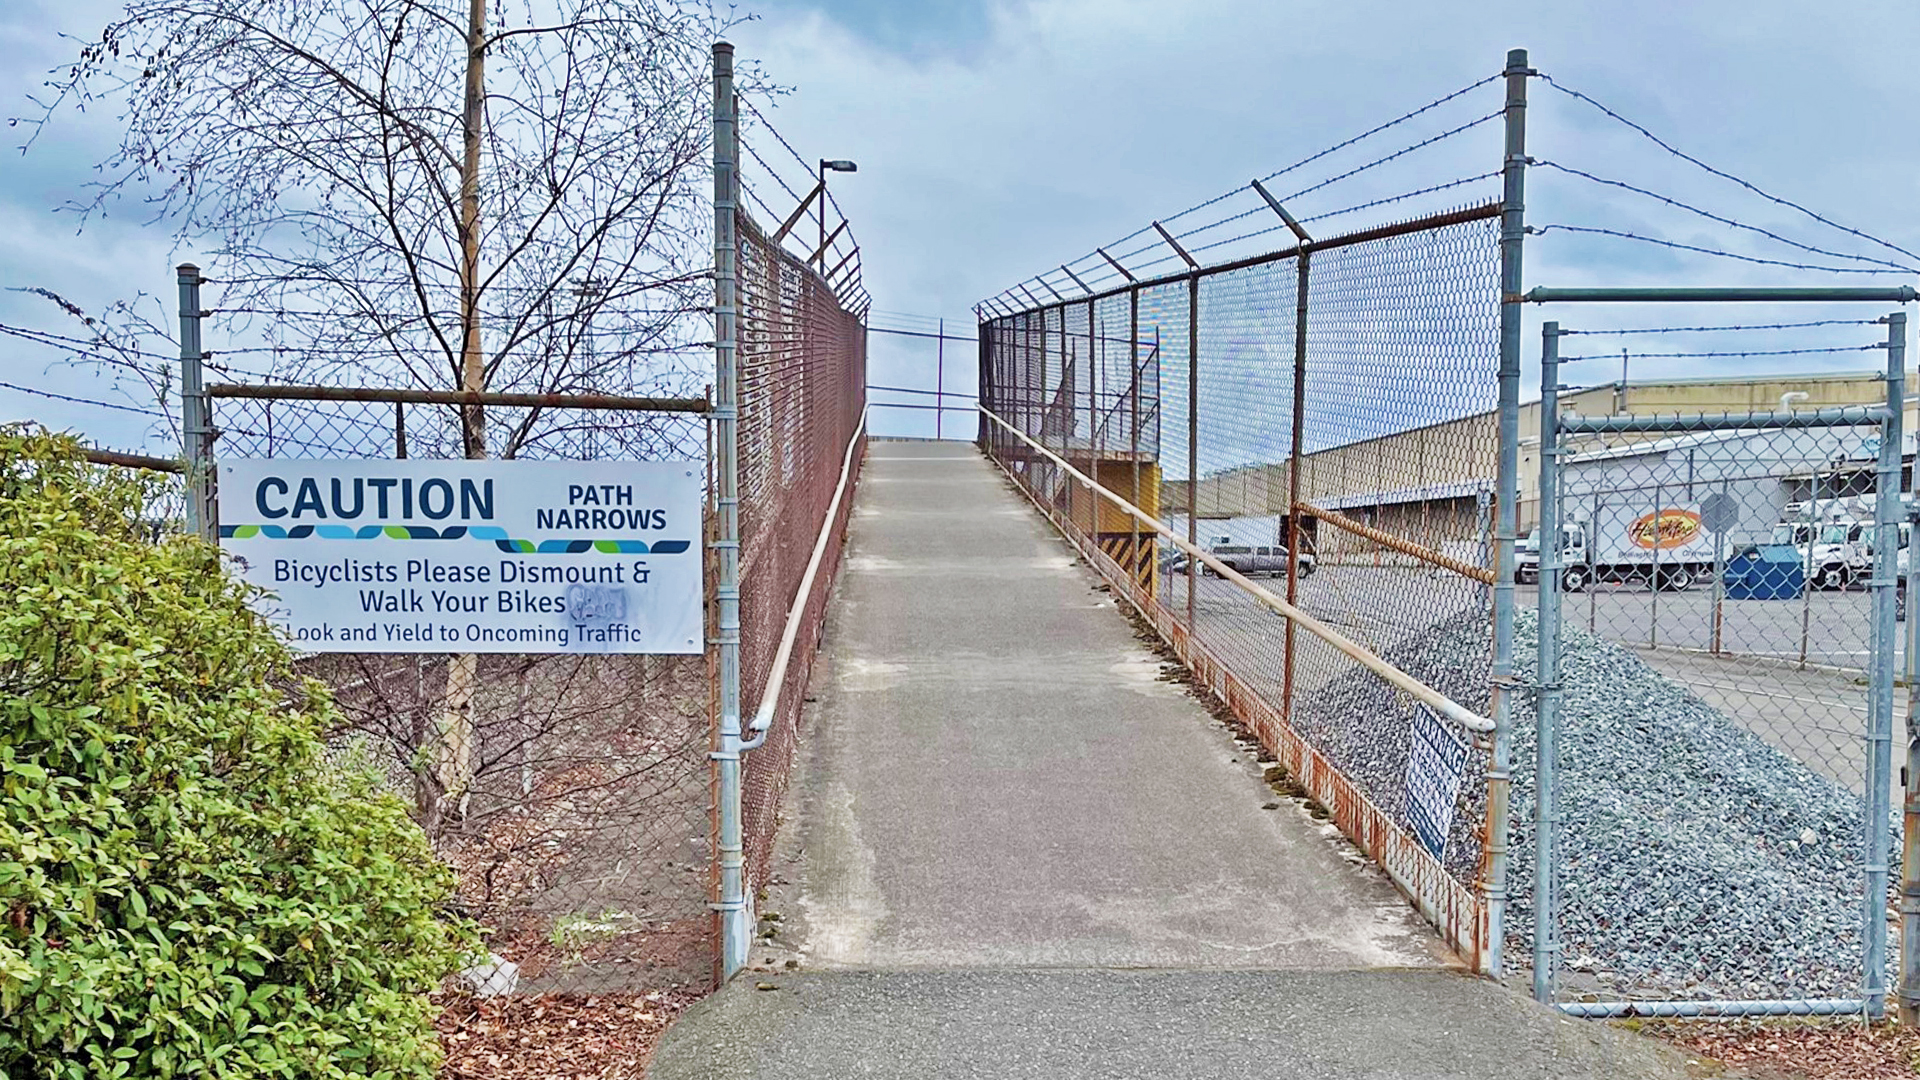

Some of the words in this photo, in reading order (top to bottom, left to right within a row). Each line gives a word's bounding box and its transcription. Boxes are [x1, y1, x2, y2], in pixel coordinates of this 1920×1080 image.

[255, 476, 494, 520] CAUTION
[568, 484, 633, 505] PATH
[536, 508, 667, 530] NARROWS
[274, 557, 398, 588] Bicyclists
[407, 558, 491, 583] Please
[500, 560, 625, 584] Dismount
[633, 560, 651, 584] &
[359, 588, 424, 613] Walk
[431, 589, 490, 613] Your
[497, 589, 566, 614] Bikes
[340, 622, 377, 642] and
[383, 622, 433, 642] Yield
[439, 624, 460, 642] to
[466, 623, 569, 647] Oncoming
[574, 622, 641, 643] Traffic
[1415, 706, 1463, 773] WARNING
